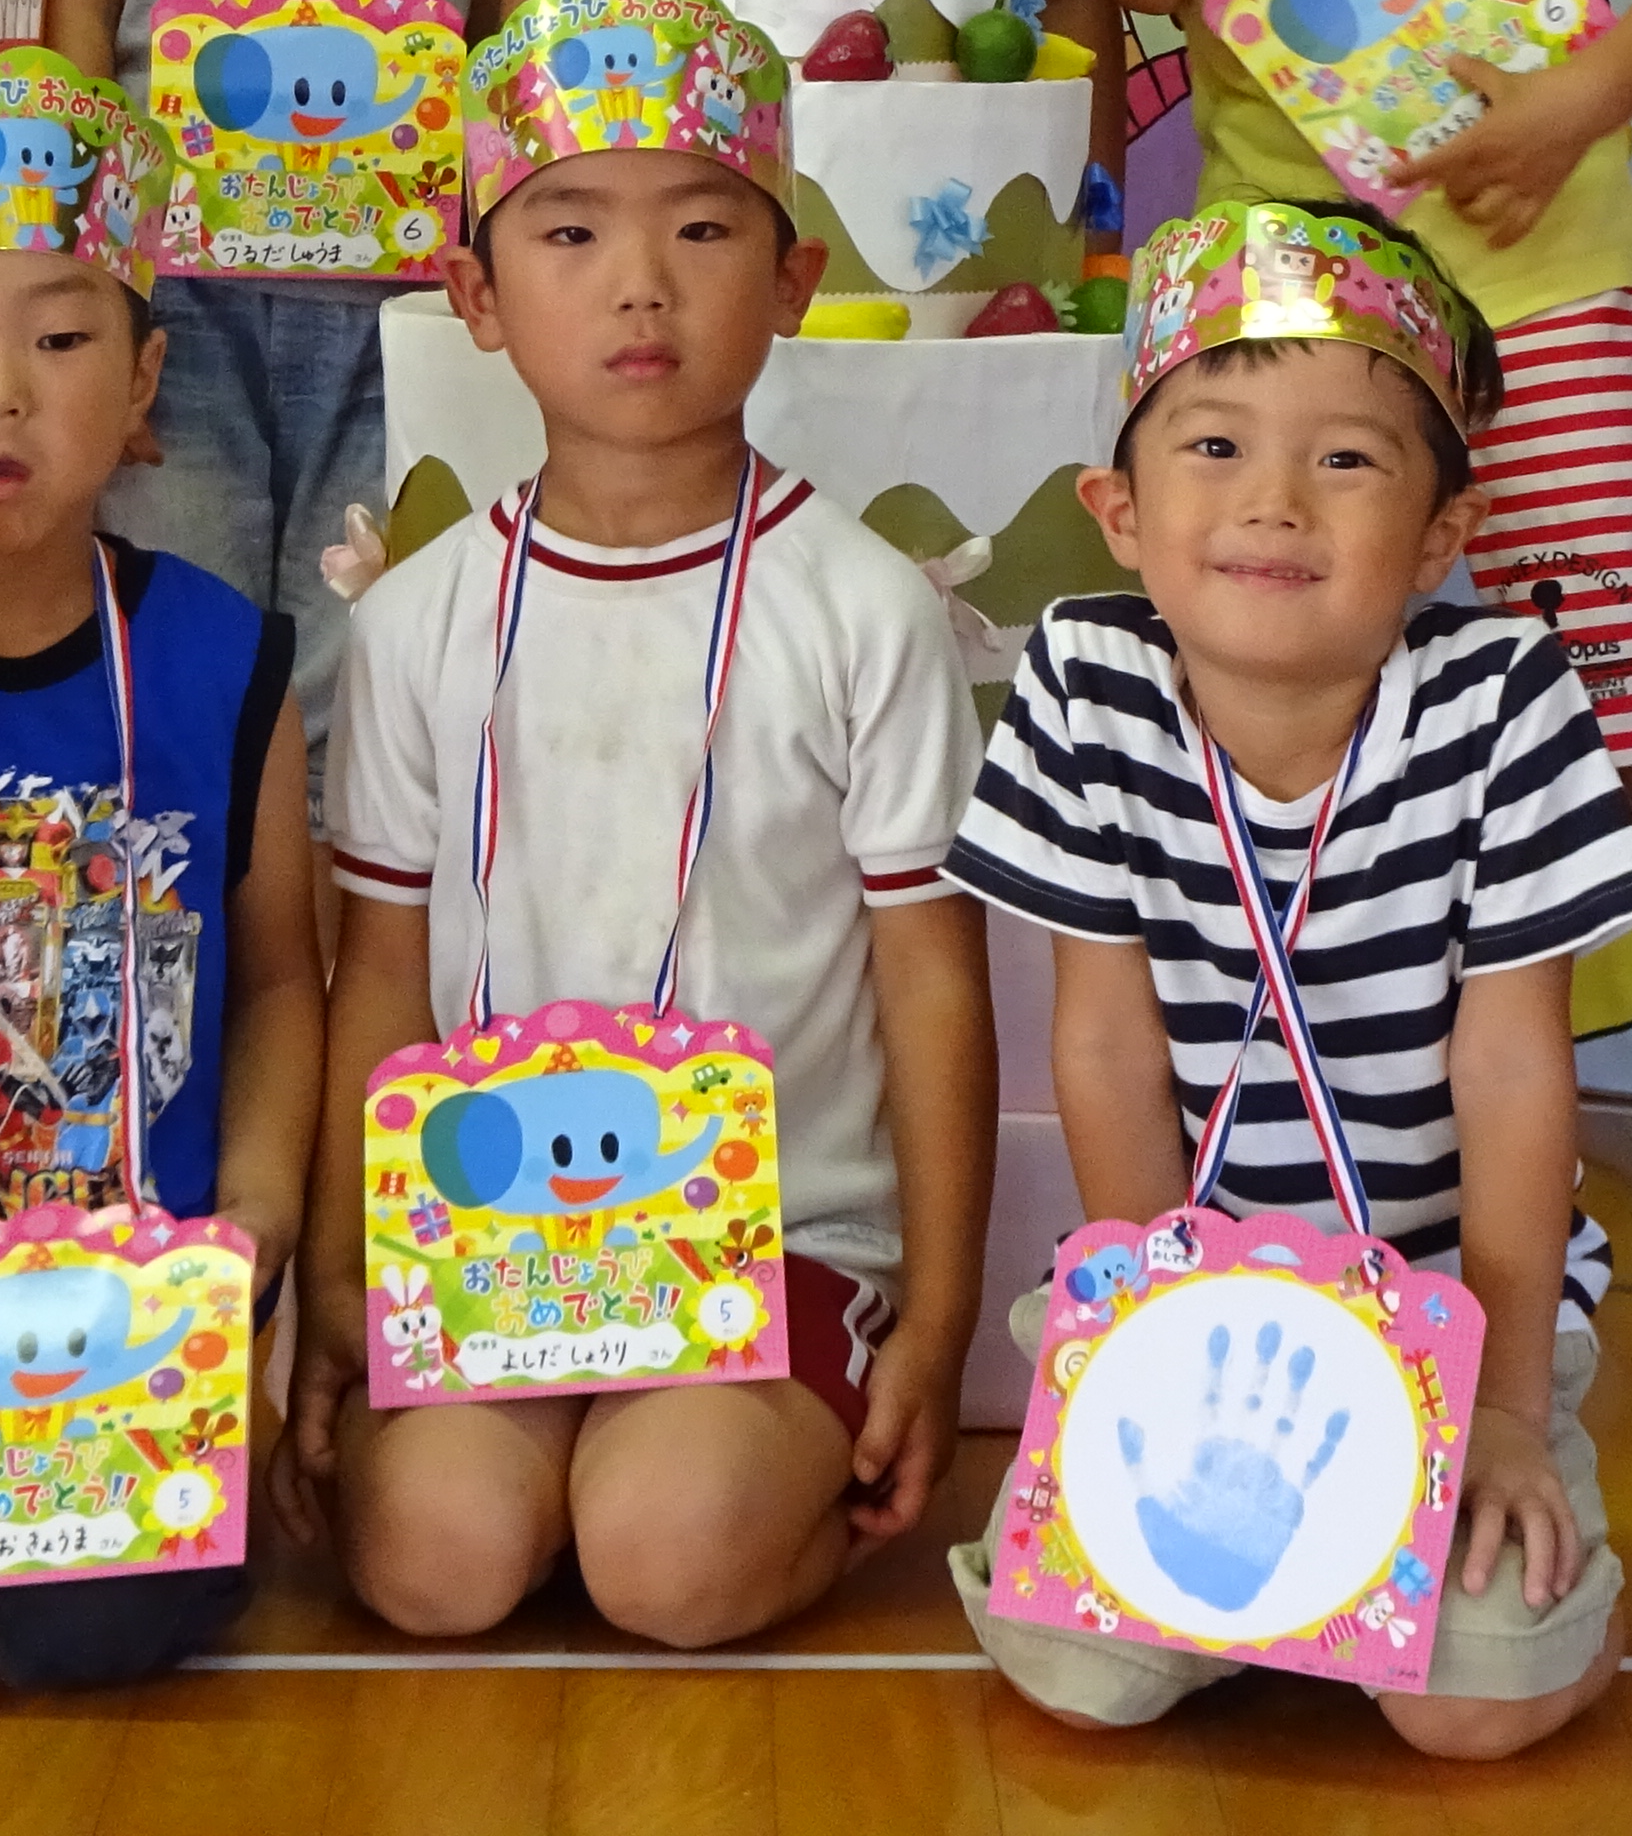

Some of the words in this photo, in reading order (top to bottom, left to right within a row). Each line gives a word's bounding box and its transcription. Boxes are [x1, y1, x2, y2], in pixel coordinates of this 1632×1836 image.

[221, 173, 366, 202] おたんじょうび
[403, 217, 423, 241] 6
[463, 1247, 654, 1294] おたんじょうび
[492, 1282, 683, 1335] おめでとう!!
[719, 1297, 734, 1324] 5
[177, 1487, 192, 1510] 5
